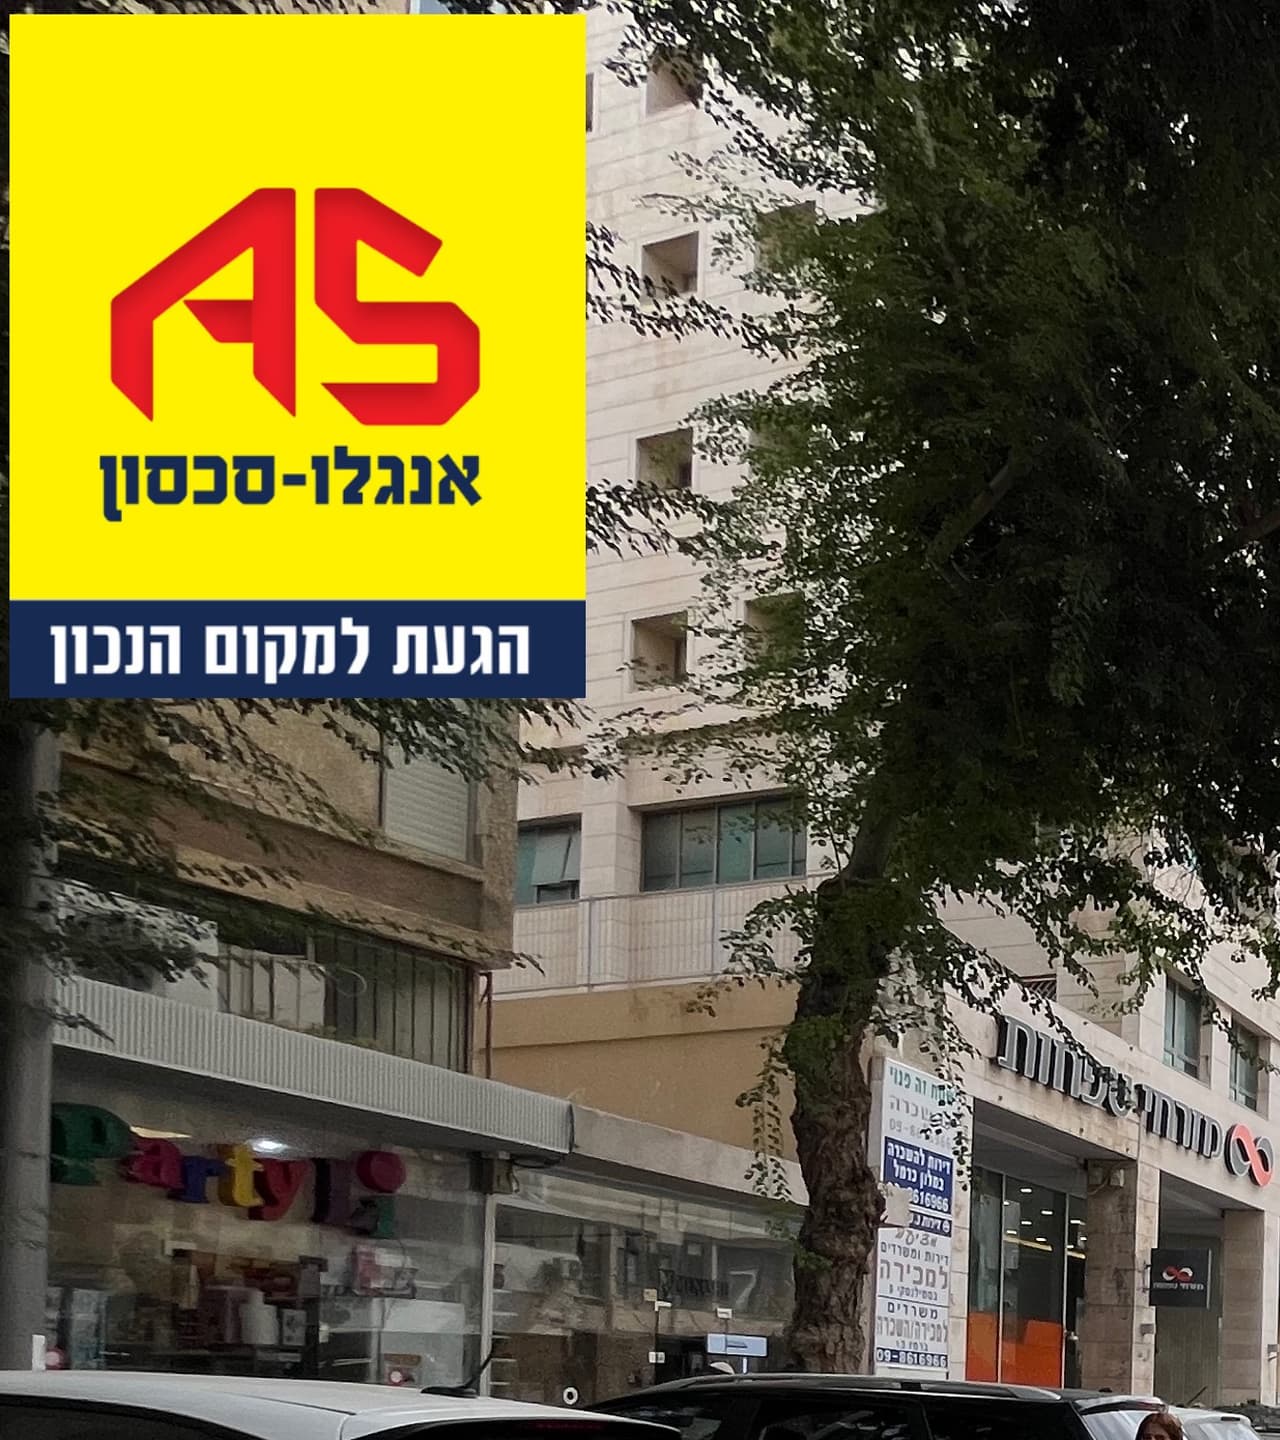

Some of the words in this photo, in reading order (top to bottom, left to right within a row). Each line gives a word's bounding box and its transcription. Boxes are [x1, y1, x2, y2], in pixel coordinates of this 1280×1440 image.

[889, 1066, 912, 1089] פנוי
[914, 1076, 927, 1096] זה
[887, 1141, 925, 1167] להשכרה
[893, 1158, 918, 1183] כרמל
[927, 1156, 951, 1175] דירות
[880, 1241, 921, 1260] ומשרדים
[925, 1250, 949, 1267] דירות
[879, 1258, 949, 1290] למכירה
[887, 1301, 938, 1320] משרדים
